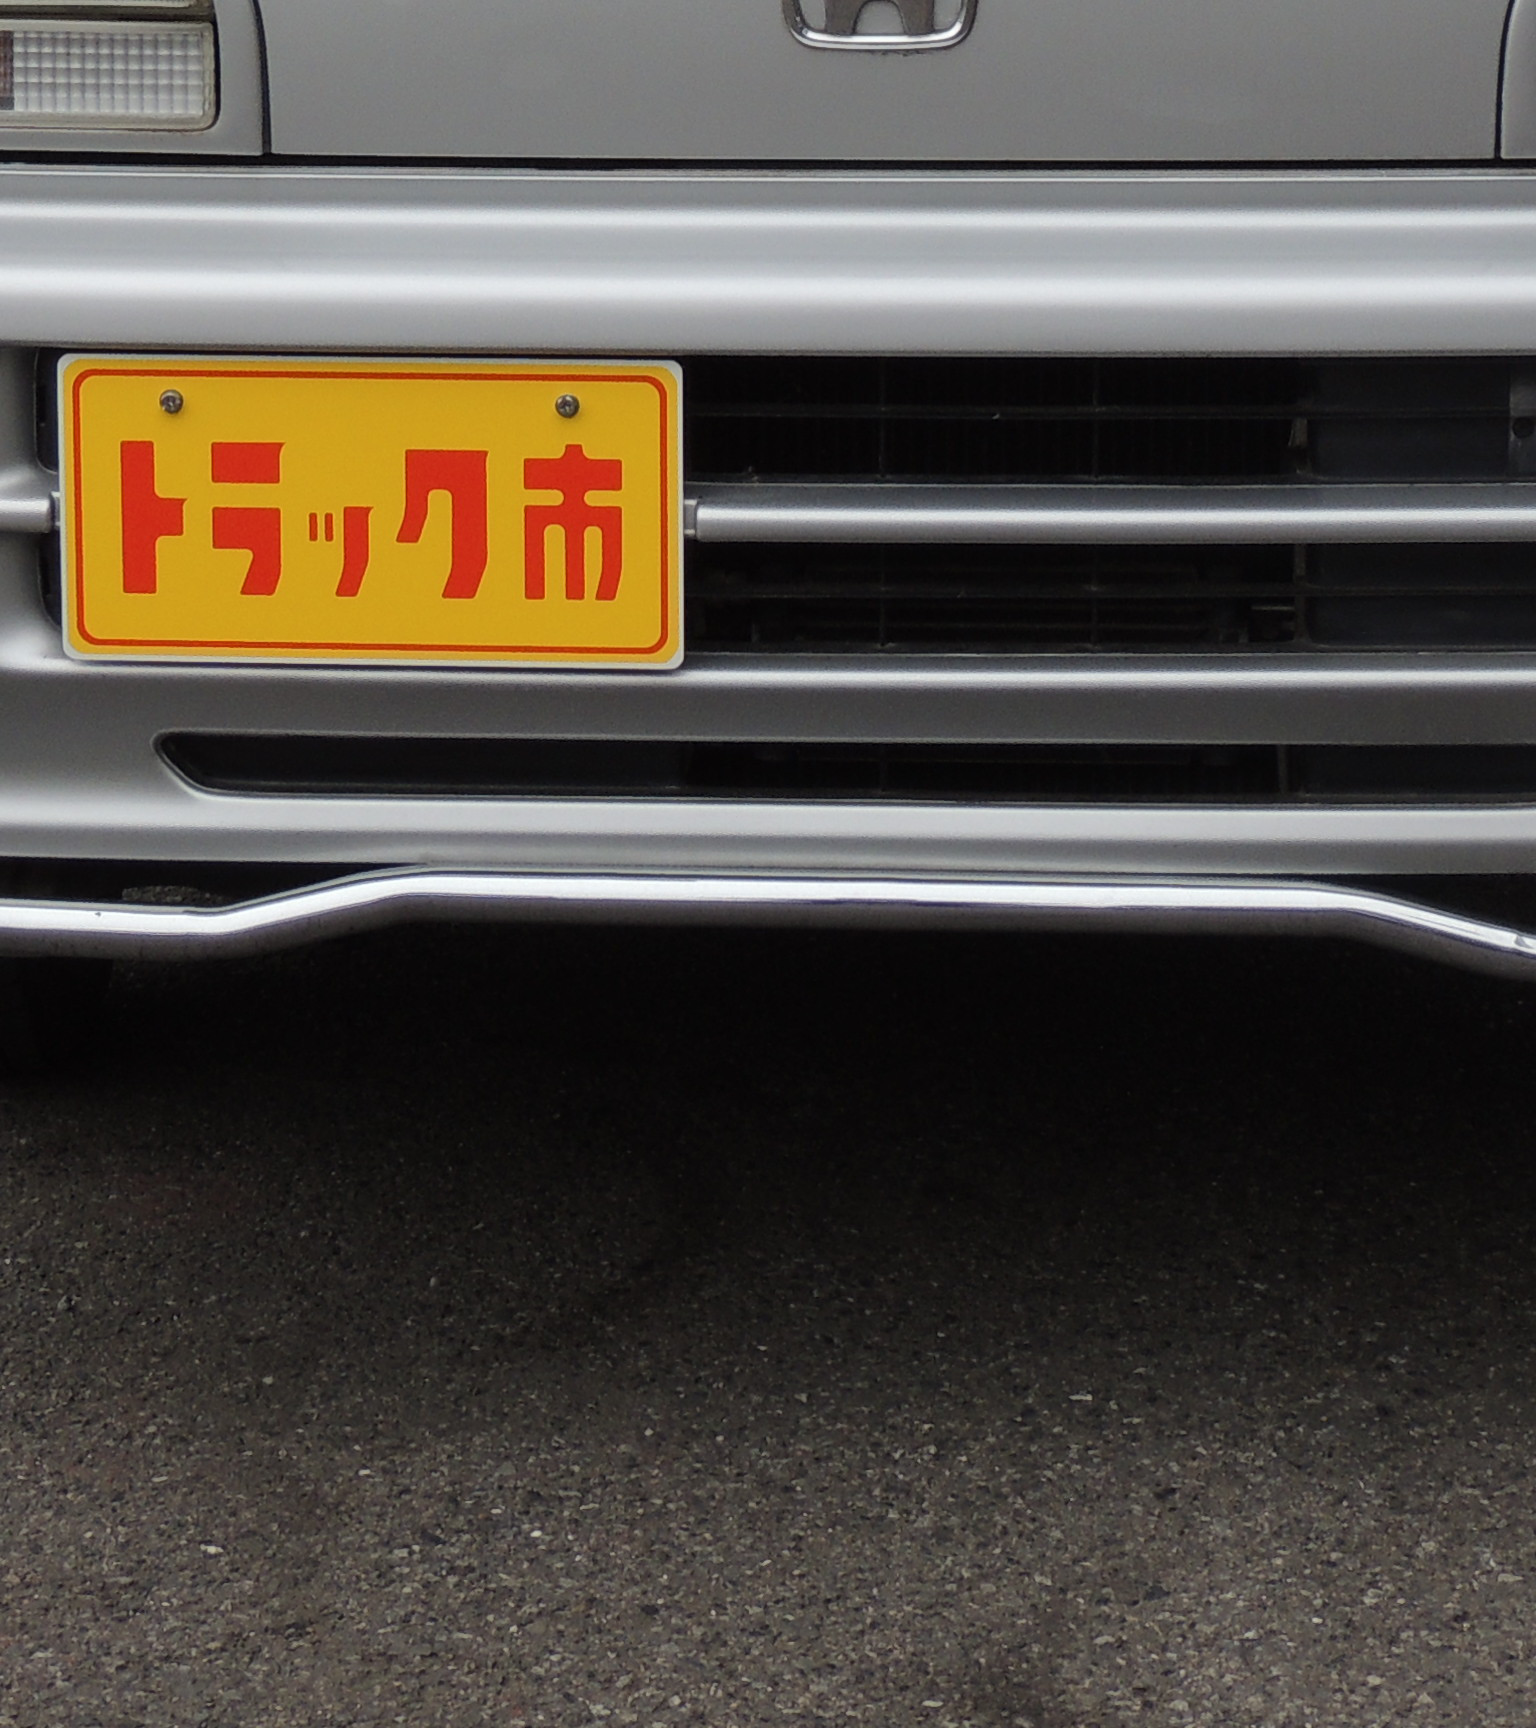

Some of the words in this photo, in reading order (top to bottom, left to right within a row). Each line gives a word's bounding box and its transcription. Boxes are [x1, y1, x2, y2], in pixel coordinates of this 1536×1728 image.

[119, 439, 623, 601] トラック市
